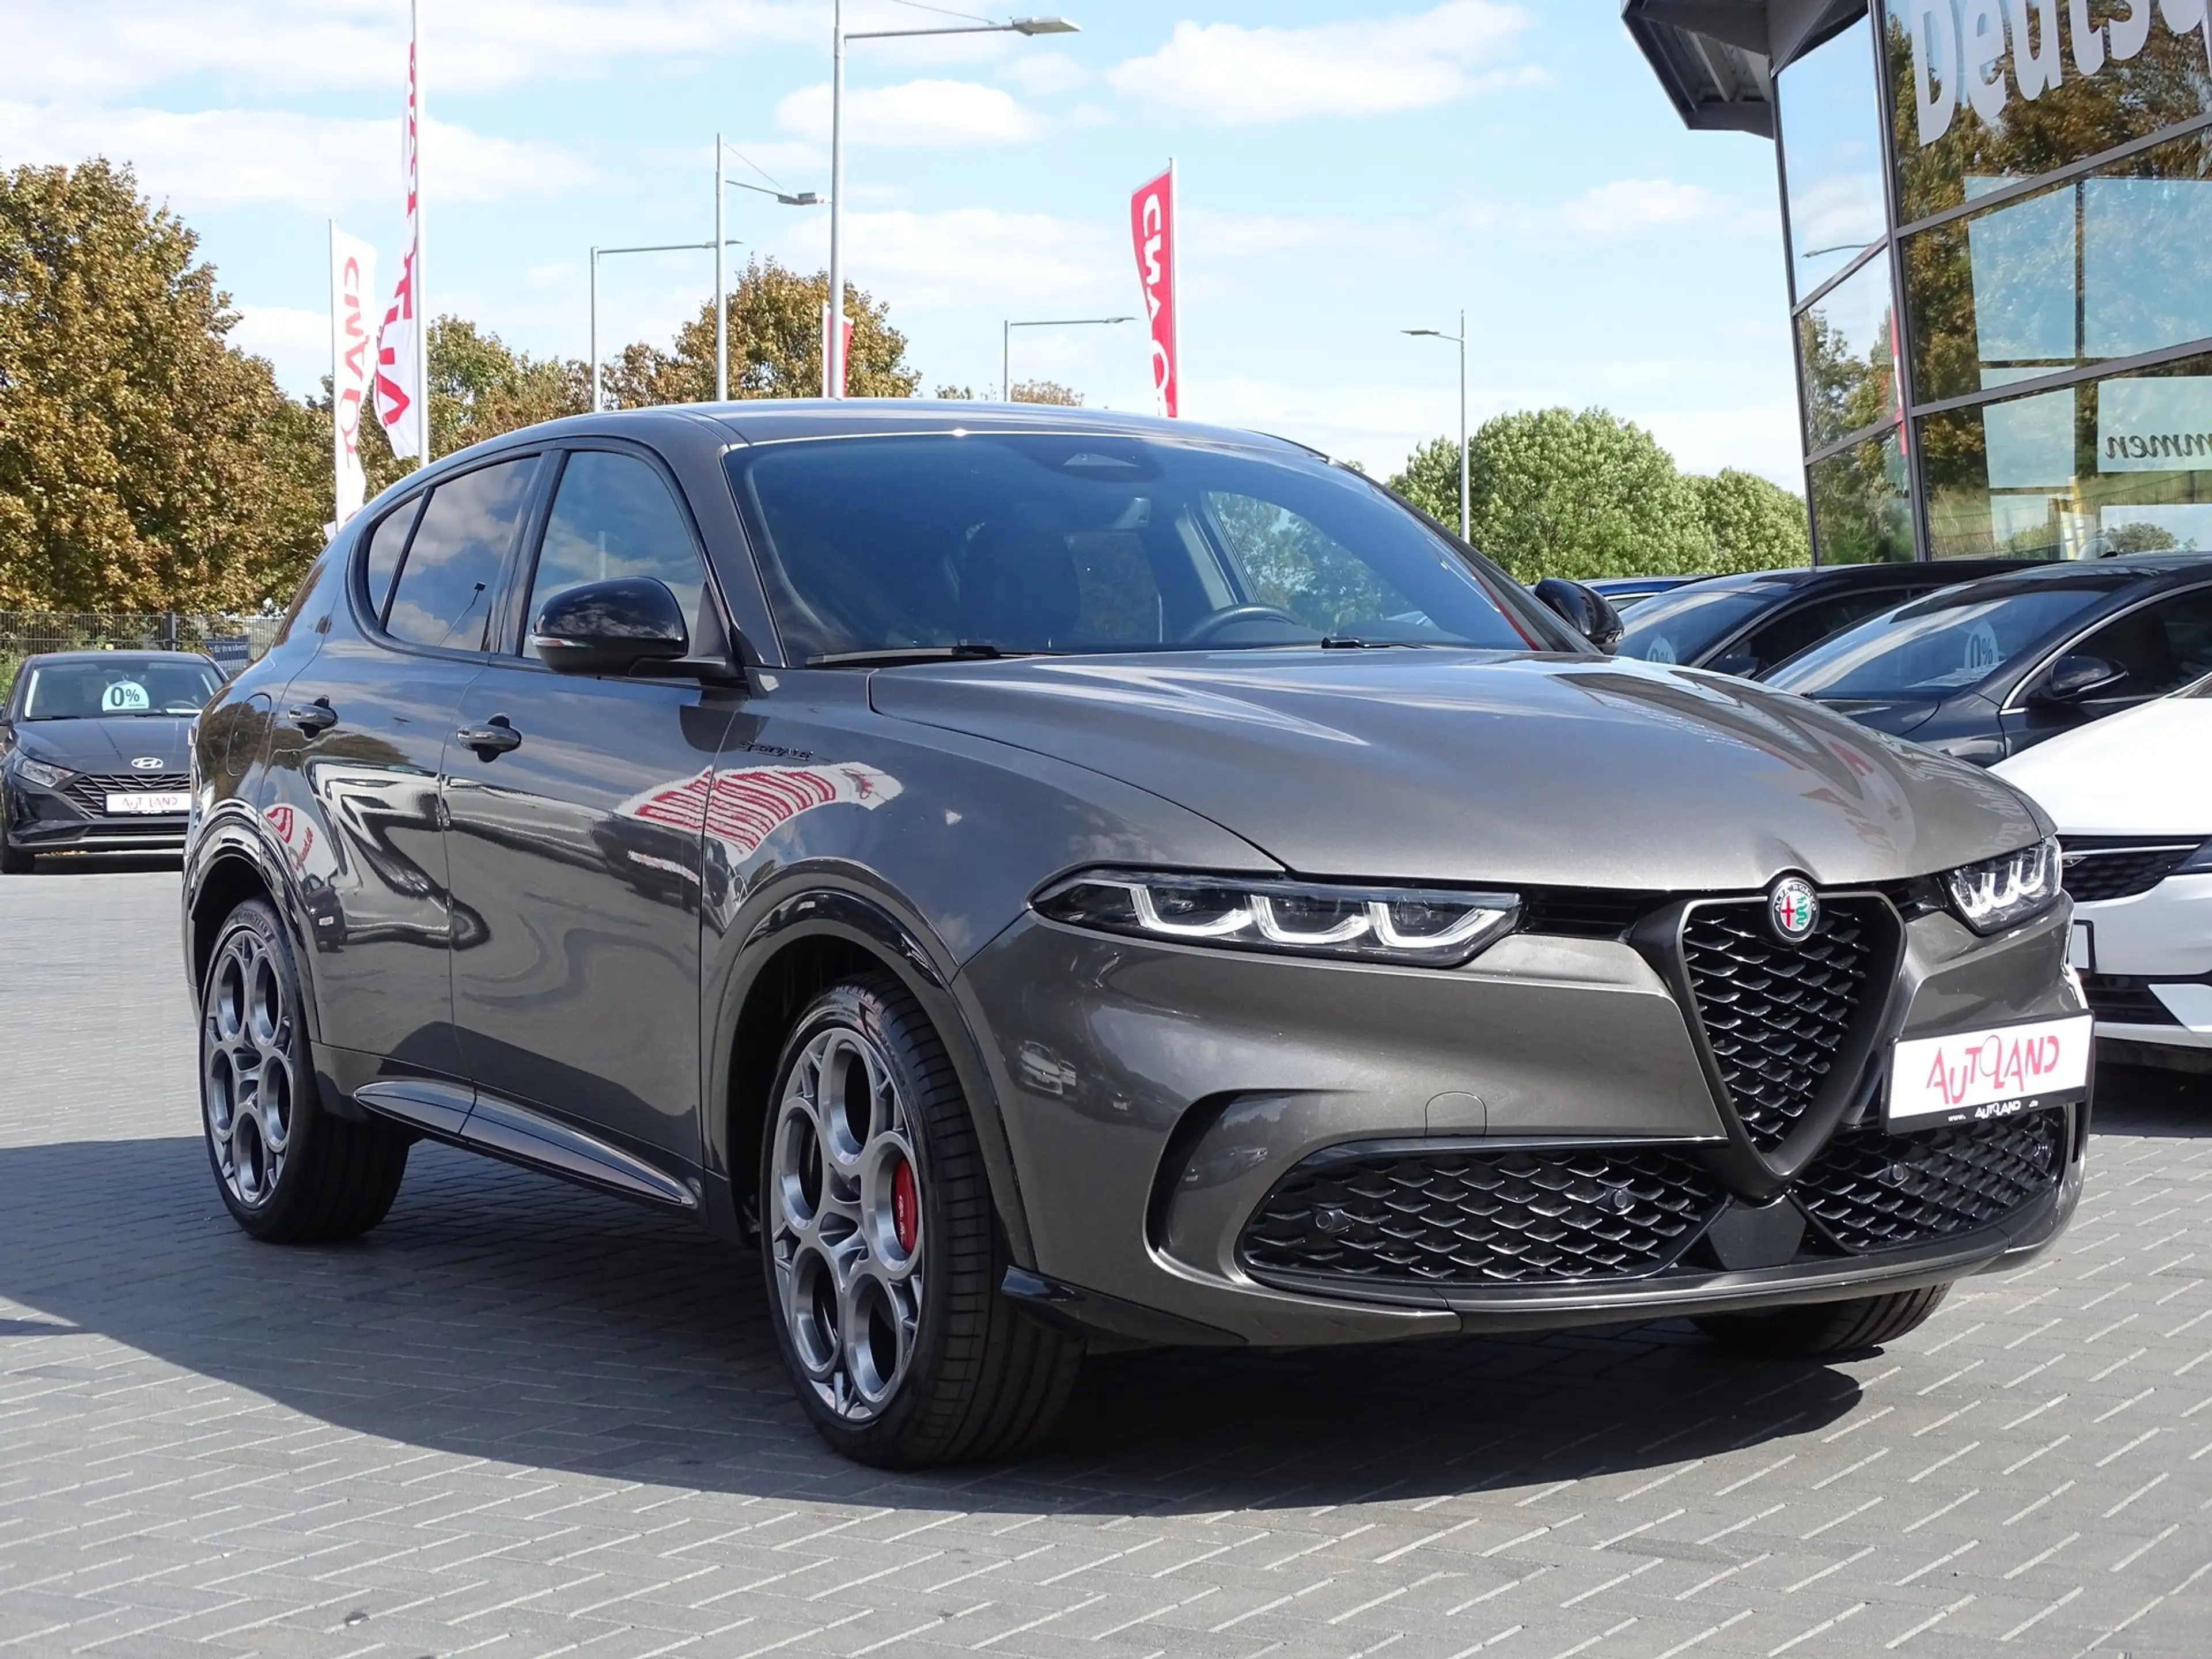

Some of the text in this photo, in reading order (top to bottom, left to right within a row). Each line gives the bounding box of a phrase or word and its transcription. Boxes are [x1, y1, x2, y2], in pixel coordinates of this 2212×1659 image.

[1971, 634, 1993, 669] 0%
[111, 687, 140, 707] 0%
[1925, 1035, 2060, 1104] AUTOLAND
[1975, 1100, 2021, 1119] AUTOLAND
